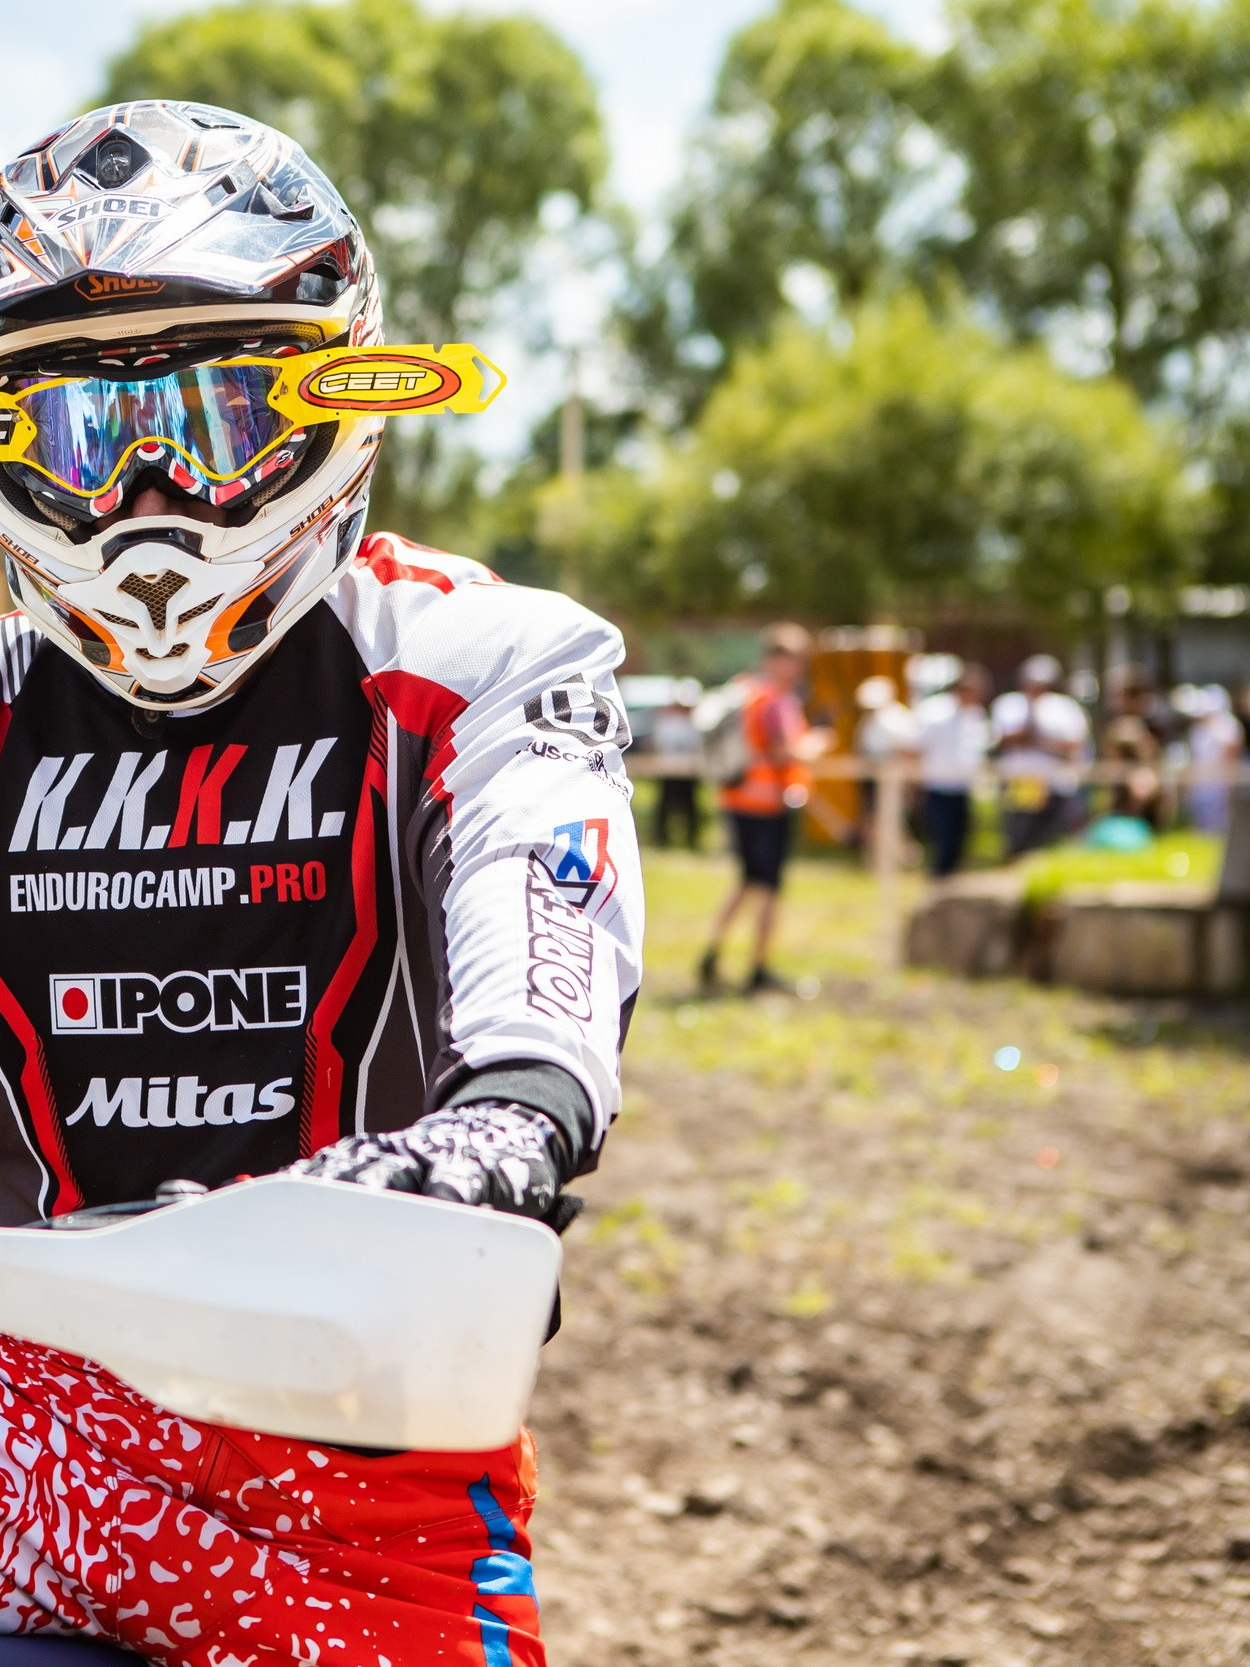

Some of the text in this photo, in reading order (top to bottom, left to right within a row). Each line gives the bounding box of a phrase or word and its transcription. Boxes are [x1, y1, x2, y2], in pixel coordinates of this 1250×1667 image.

[57, 198, 161, 229] SHOEI
[318, 371, 427, 395] CEET
[289, 494, 335, 538] SHOEI
[0, 533, 40, 566] SHOEI
[9, 860, 327, 913] ENDUROCAMP.PRO
[97, 965, 308, 1035] IPONE
[65, 1075, 296, 1128] Mitas
